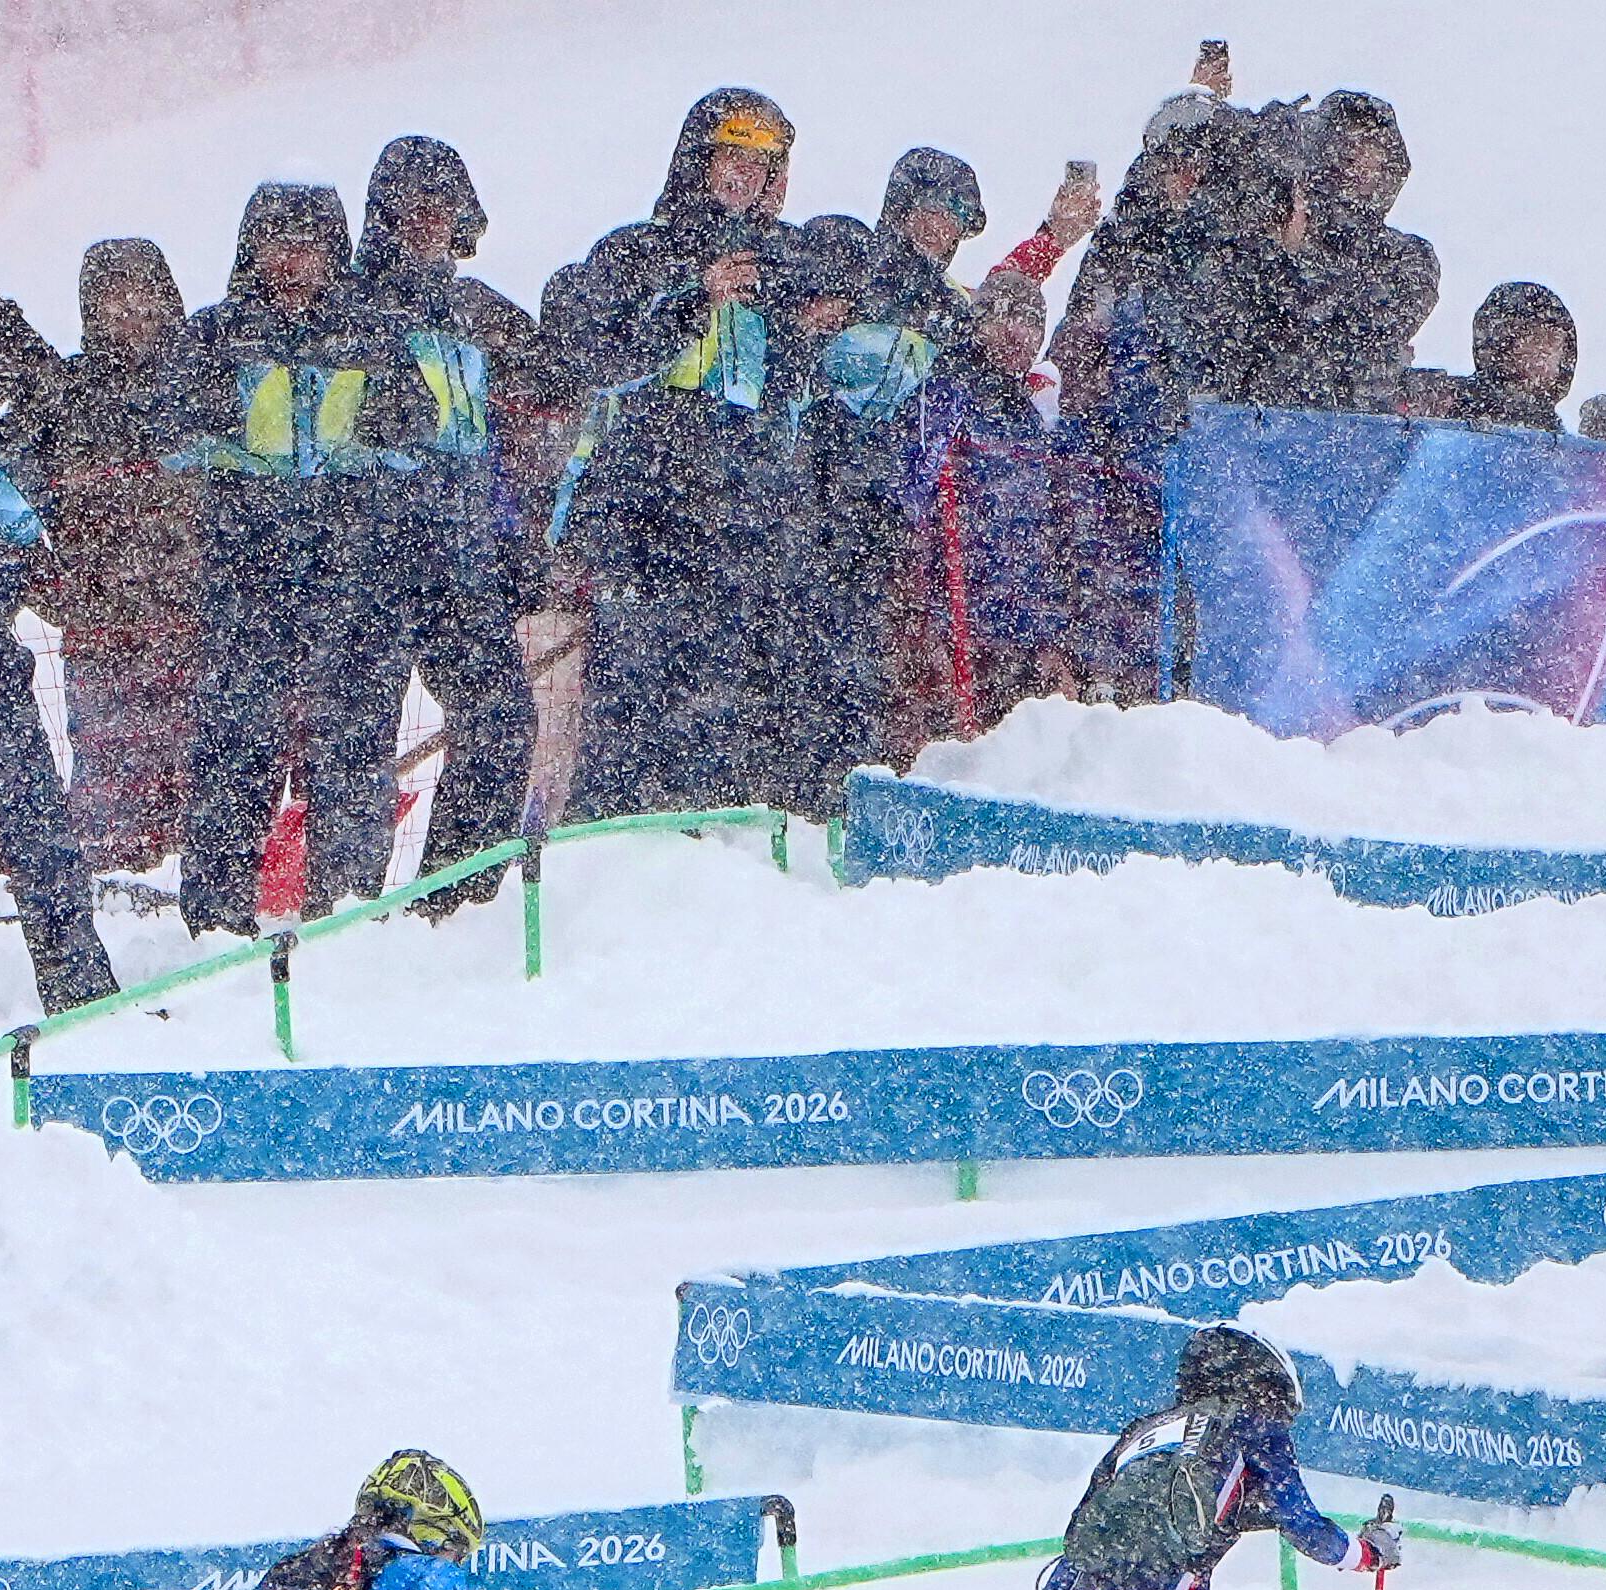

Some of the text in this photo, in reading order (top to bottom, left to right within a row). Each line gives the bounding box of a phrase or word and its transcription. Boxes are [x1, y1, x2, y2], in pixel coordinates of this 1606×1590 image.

[393, 1091, 849, 1136] MILANO CORTINA 2026
[1313, 1075, 1489, 1111] MILANO
[1040, 1229, 1452, 1306] MILANO CORTINA 2026
[835, 1334, 1087, 1389] MILANO CORTINA 2026
[1138, 1431, 1156, 1451] 5
[1327, 1403, 1582, 1467] MILANO CORTINA 2026
[469, 1533, 667, 1576] TINA 2026
